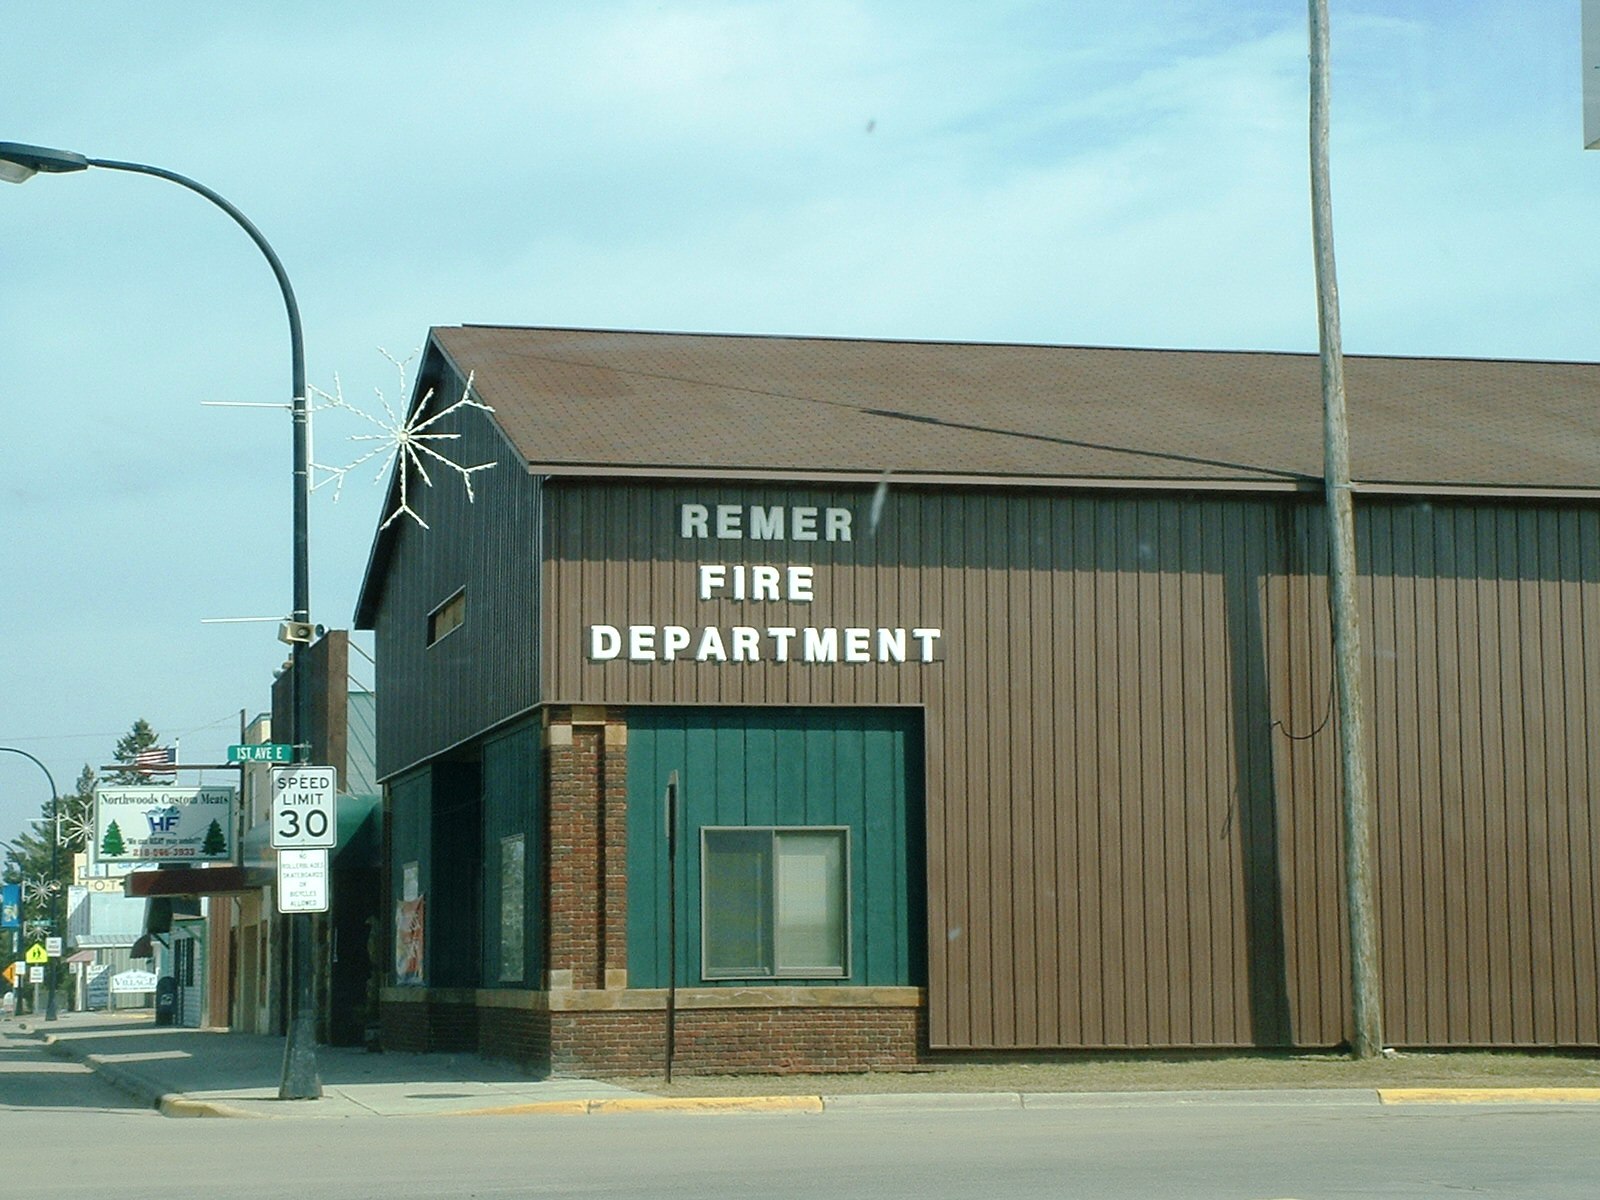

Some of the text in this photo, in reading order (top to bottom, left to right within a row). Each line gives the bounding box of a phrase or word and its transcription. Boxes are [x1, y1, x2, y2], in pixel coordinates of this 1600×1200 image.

[681, 503, 853, 542] REMER
[699, 565, 814, 602] FIRE
[590, 624, 941, 663] DEPARTMENT
[236, 746, 283, 760] 1ST AVE E
[277, 777, 330, 790] SPEED
[101, 793, 229, 805] Northwoods Custom Meats
[282, 793, 324, 806] LIMIT
[149, 816, 180, 832] HF
[278, 809, 329, 839] 30
